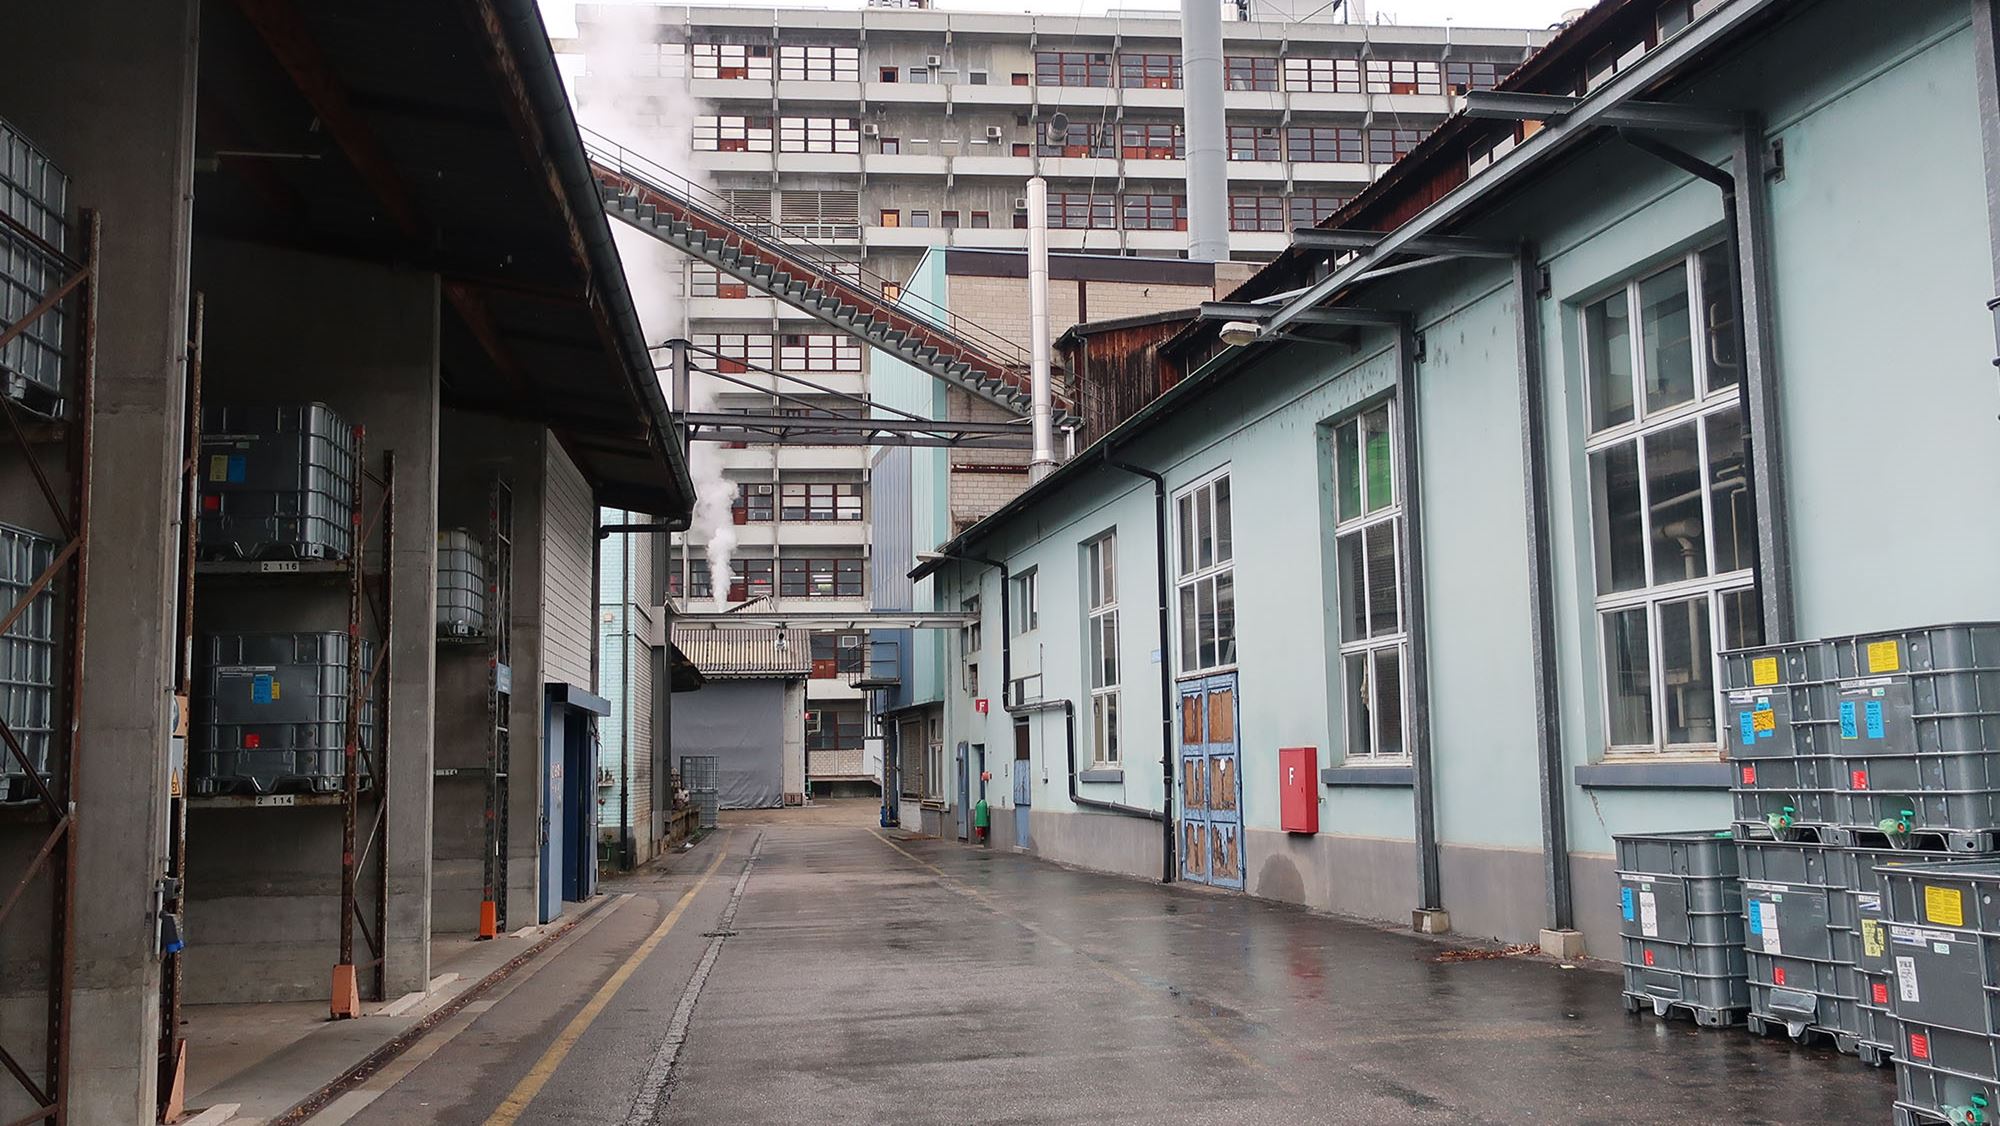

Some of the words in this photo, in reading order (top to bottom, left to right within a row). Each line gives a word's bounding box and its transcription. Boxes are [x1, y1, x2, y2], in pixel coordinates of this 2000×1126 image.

[263, 563, 269, 571] 2
[279, 563, 297, 571] 116
[1289, 767, 1294, 785] F
[273, 796, 292, 804] 114
